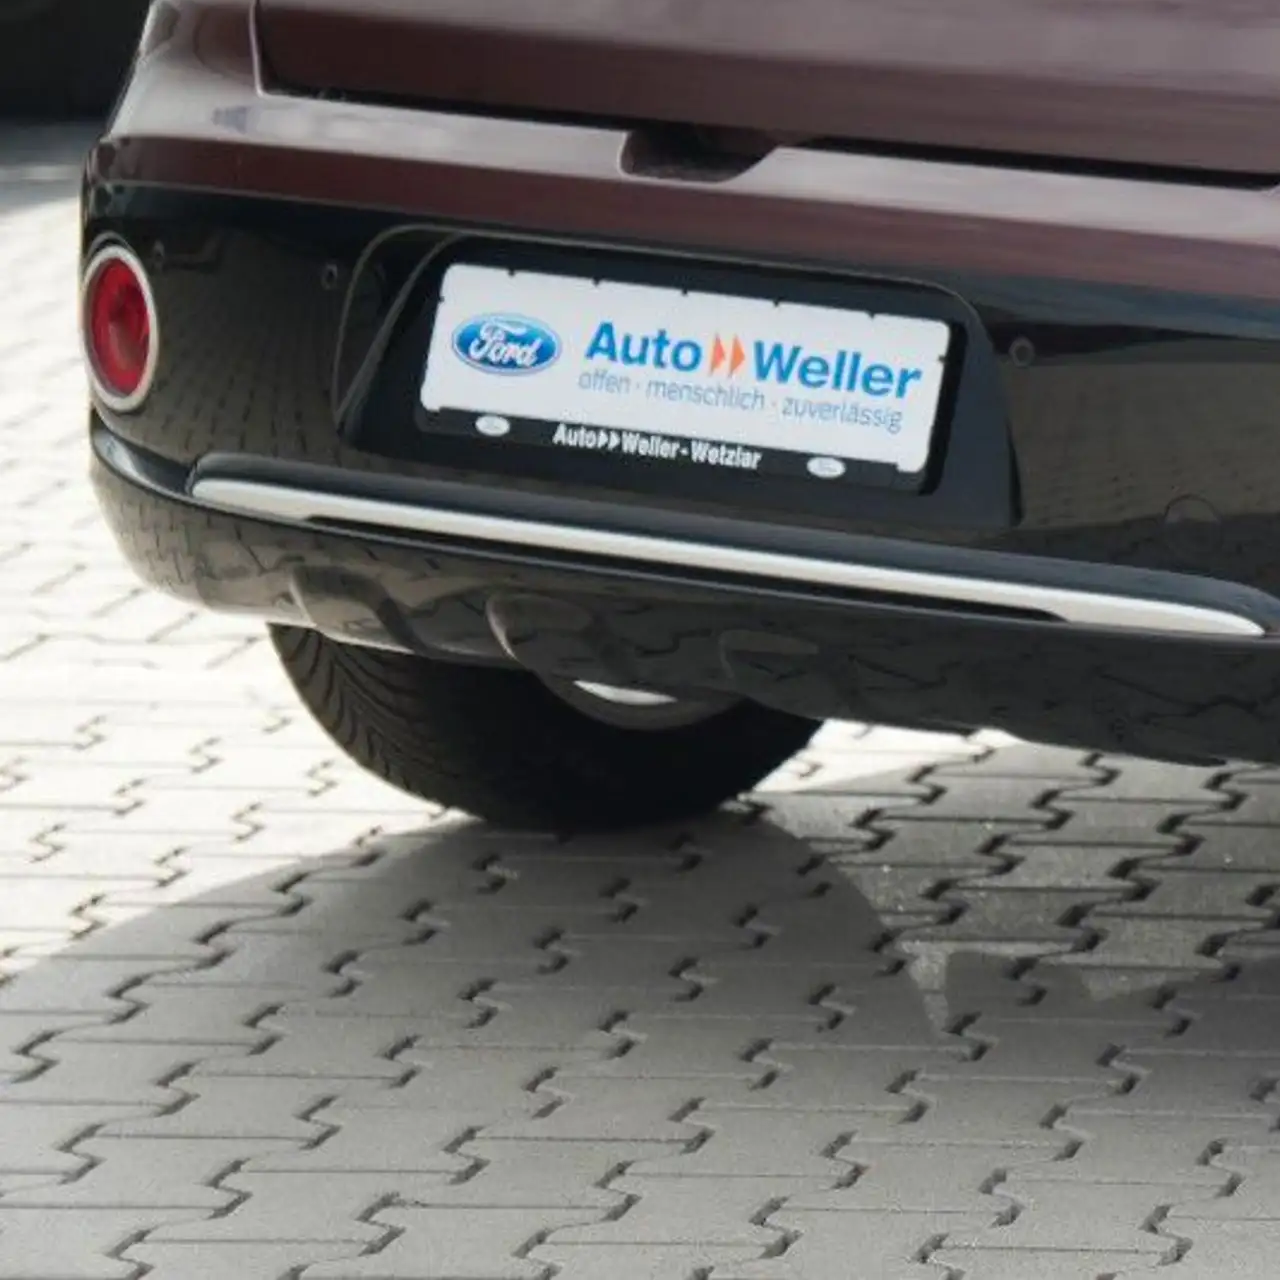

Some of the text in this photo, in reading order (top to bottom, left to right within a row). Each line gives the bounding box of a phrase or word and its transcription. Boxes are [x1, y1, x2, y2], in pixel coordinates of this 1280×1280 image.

[468, 320, 542, 367] Ford
[584, 320, 923, 400] Auto Weller
[646, 378, 766, 411] menschlich
[551, 422, 596, 448] Auto
